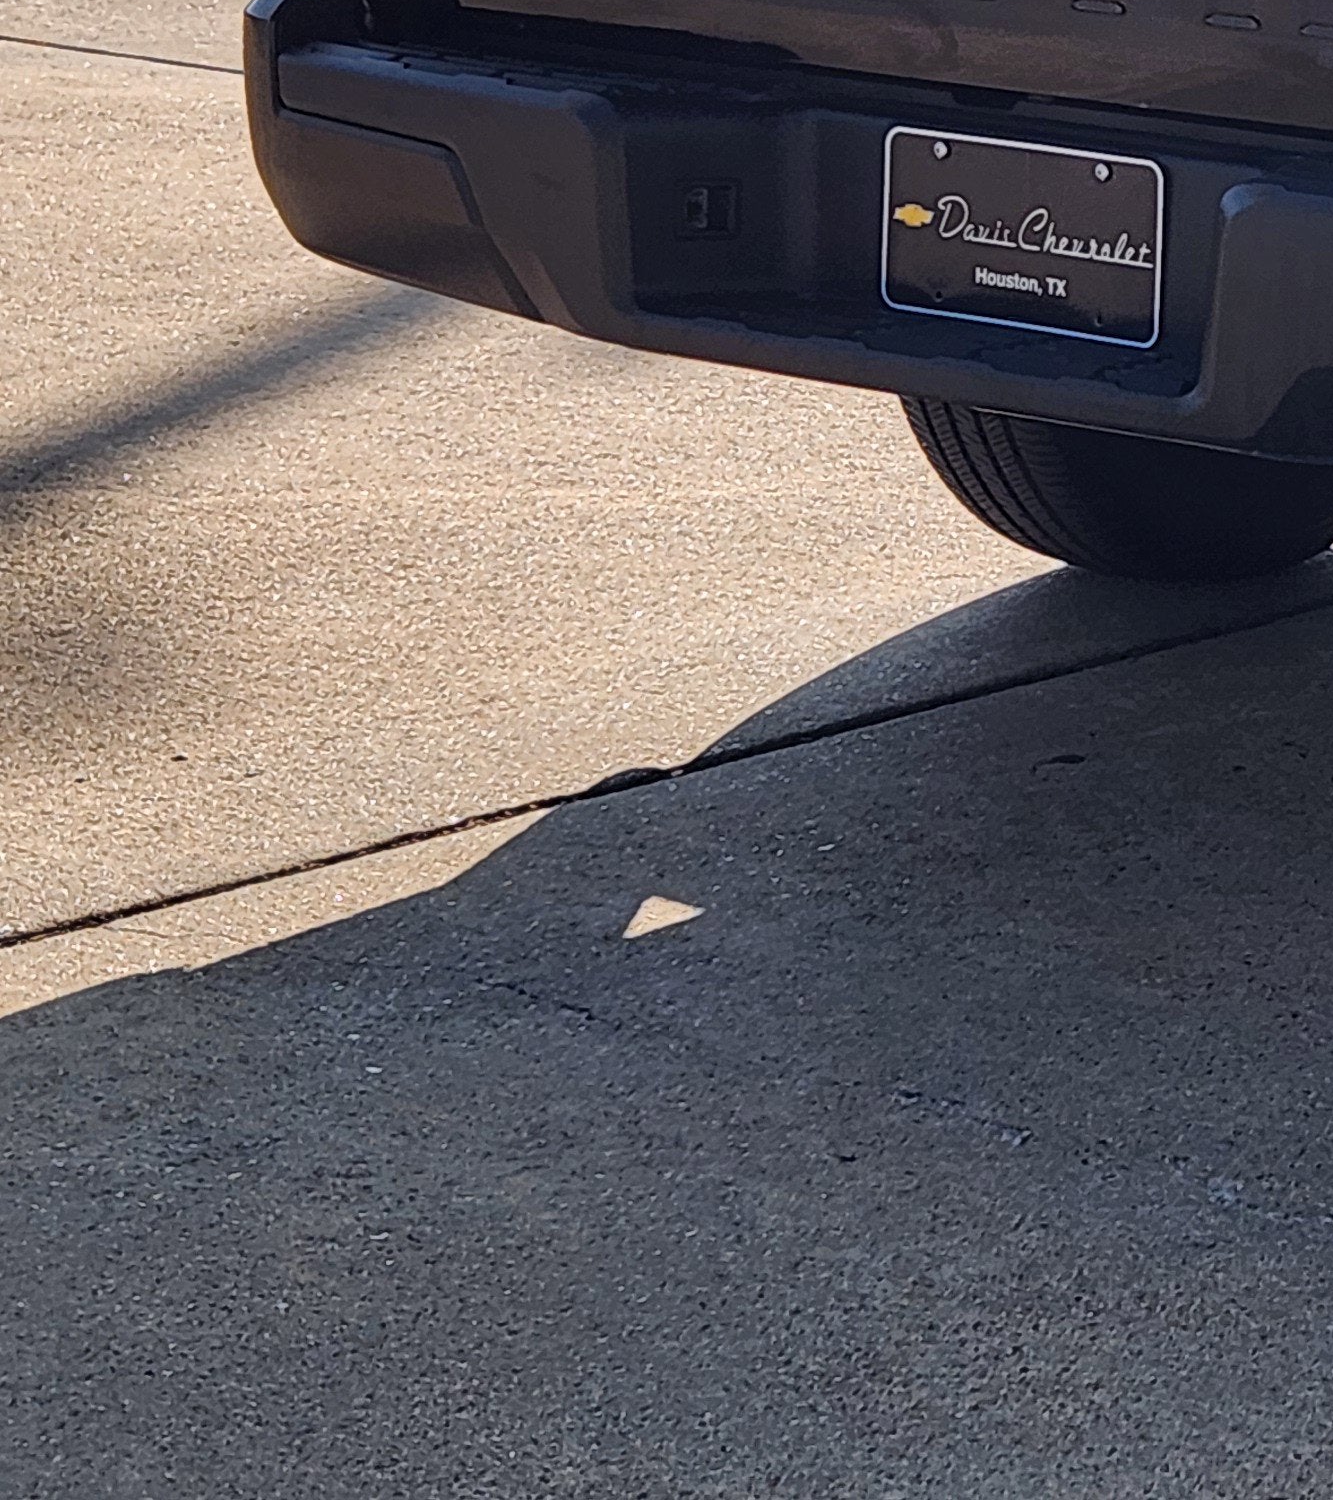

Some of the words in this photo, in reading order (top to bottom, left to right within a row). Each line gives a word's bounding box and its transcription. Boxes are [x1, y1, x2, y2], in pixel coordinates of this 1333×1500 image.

[937, 194, 1018, 248] Davis
[1018, 207, 1154, 269] Chevrolet
[974, 266, 1043, 296] Houston,
[1045, 276, 1067, 297] TX
